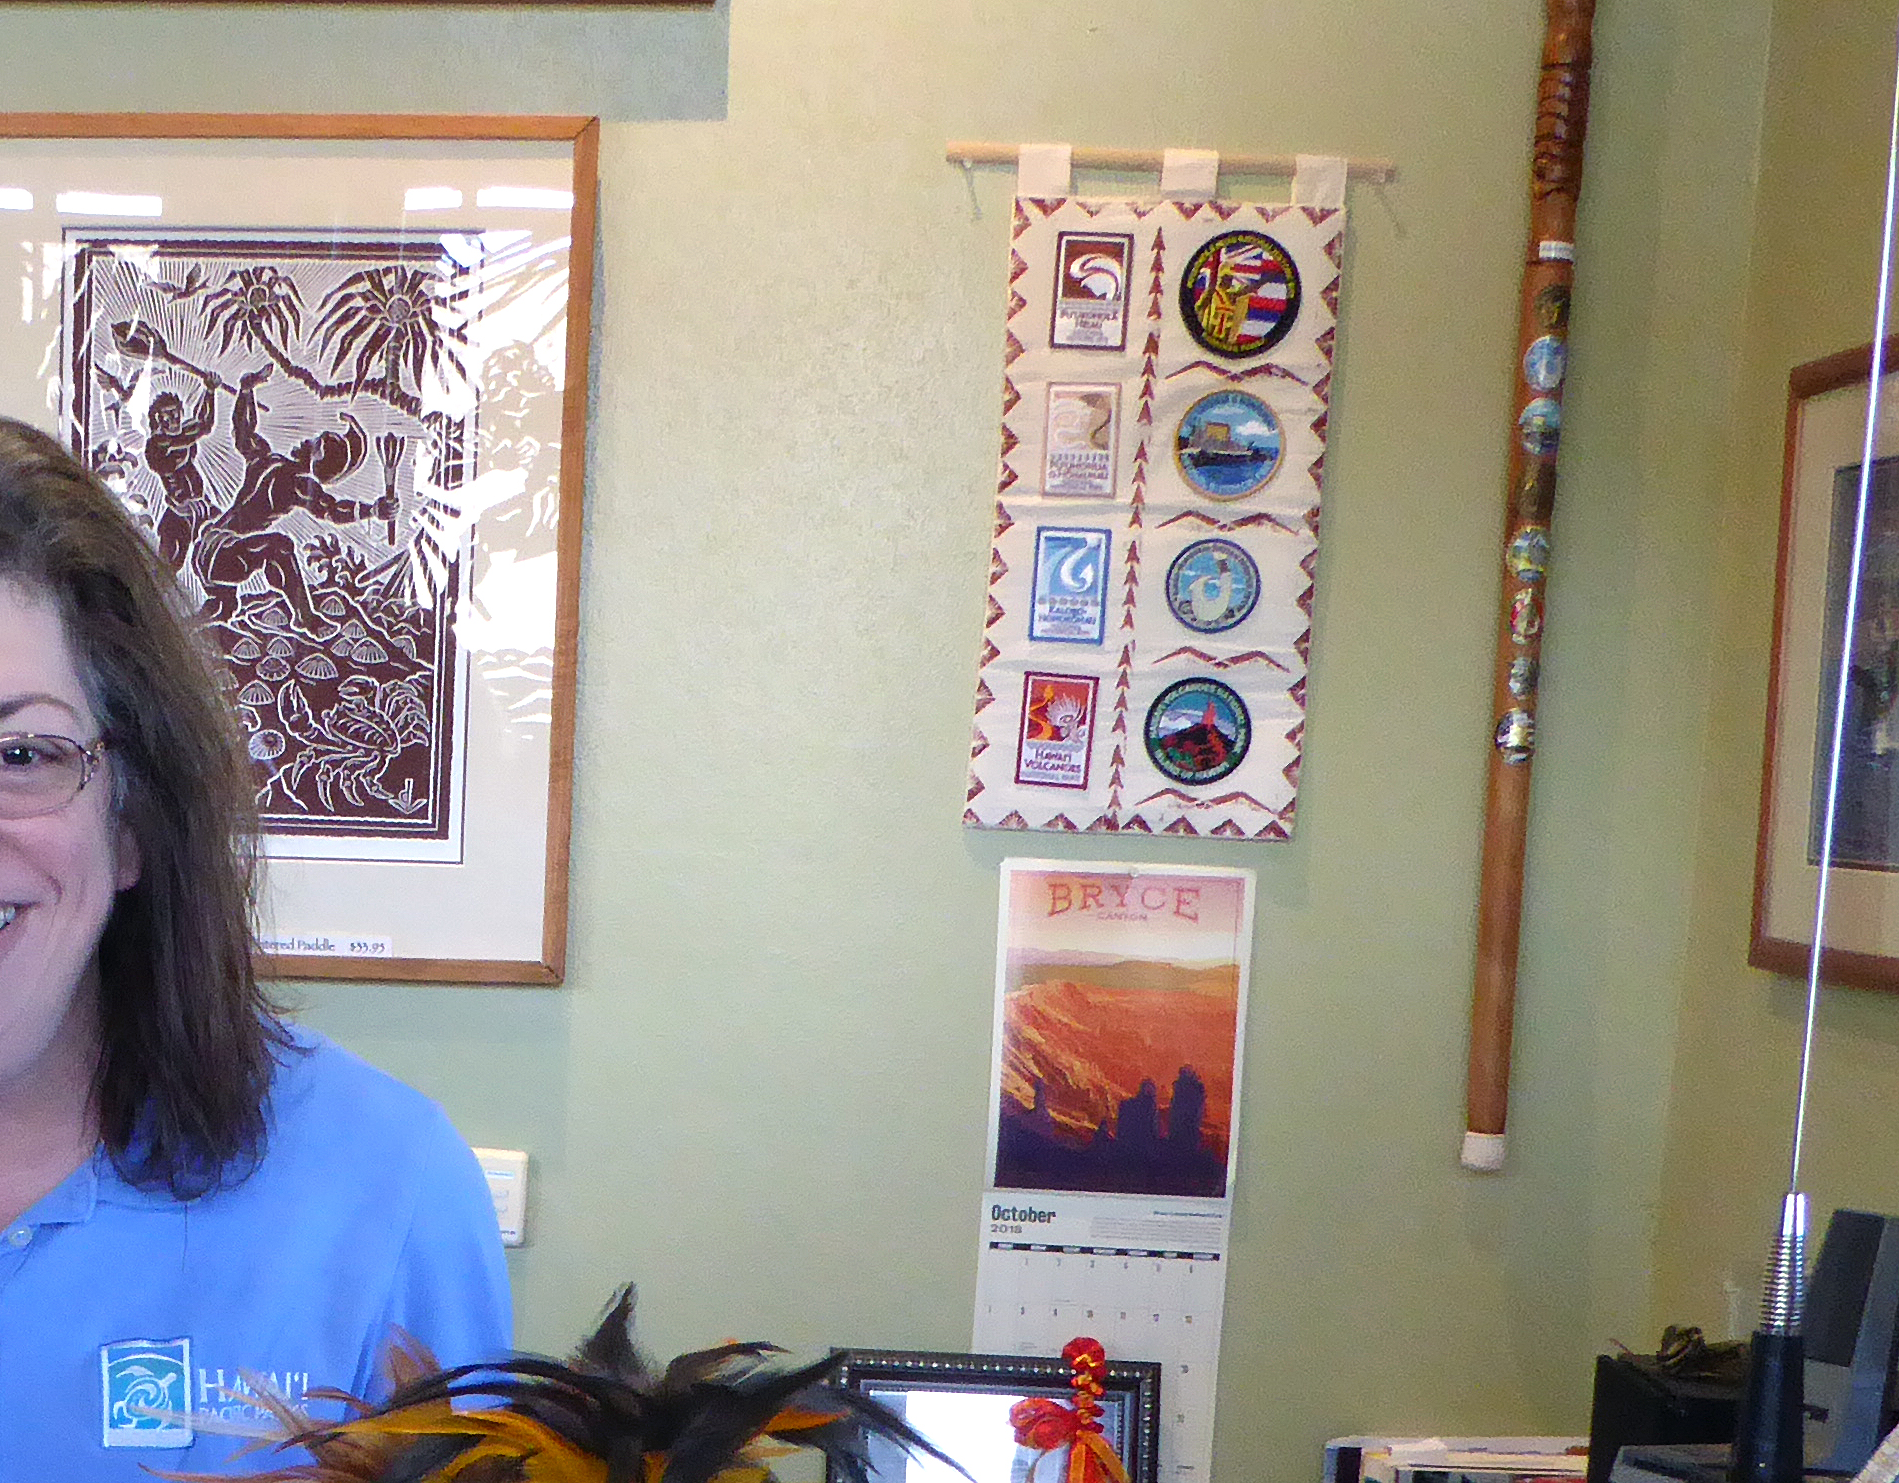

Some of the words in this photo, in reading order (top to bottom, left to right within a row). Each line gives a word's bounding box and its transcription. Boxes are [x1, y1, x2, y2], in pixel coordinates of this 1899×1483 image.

[1024, 759, 1082, 772] VOLCANOES
[1047, 881, 1200, 923] BRYCE
[1097, 910, 1148, 922] CANYON
[298, 938, 335, 951] Paddle
[991, 1204, 1056, 1223] October
[990, 1224, 1022, 1233] 2018
[199, 1369, 308, 1403] HAAI'I
